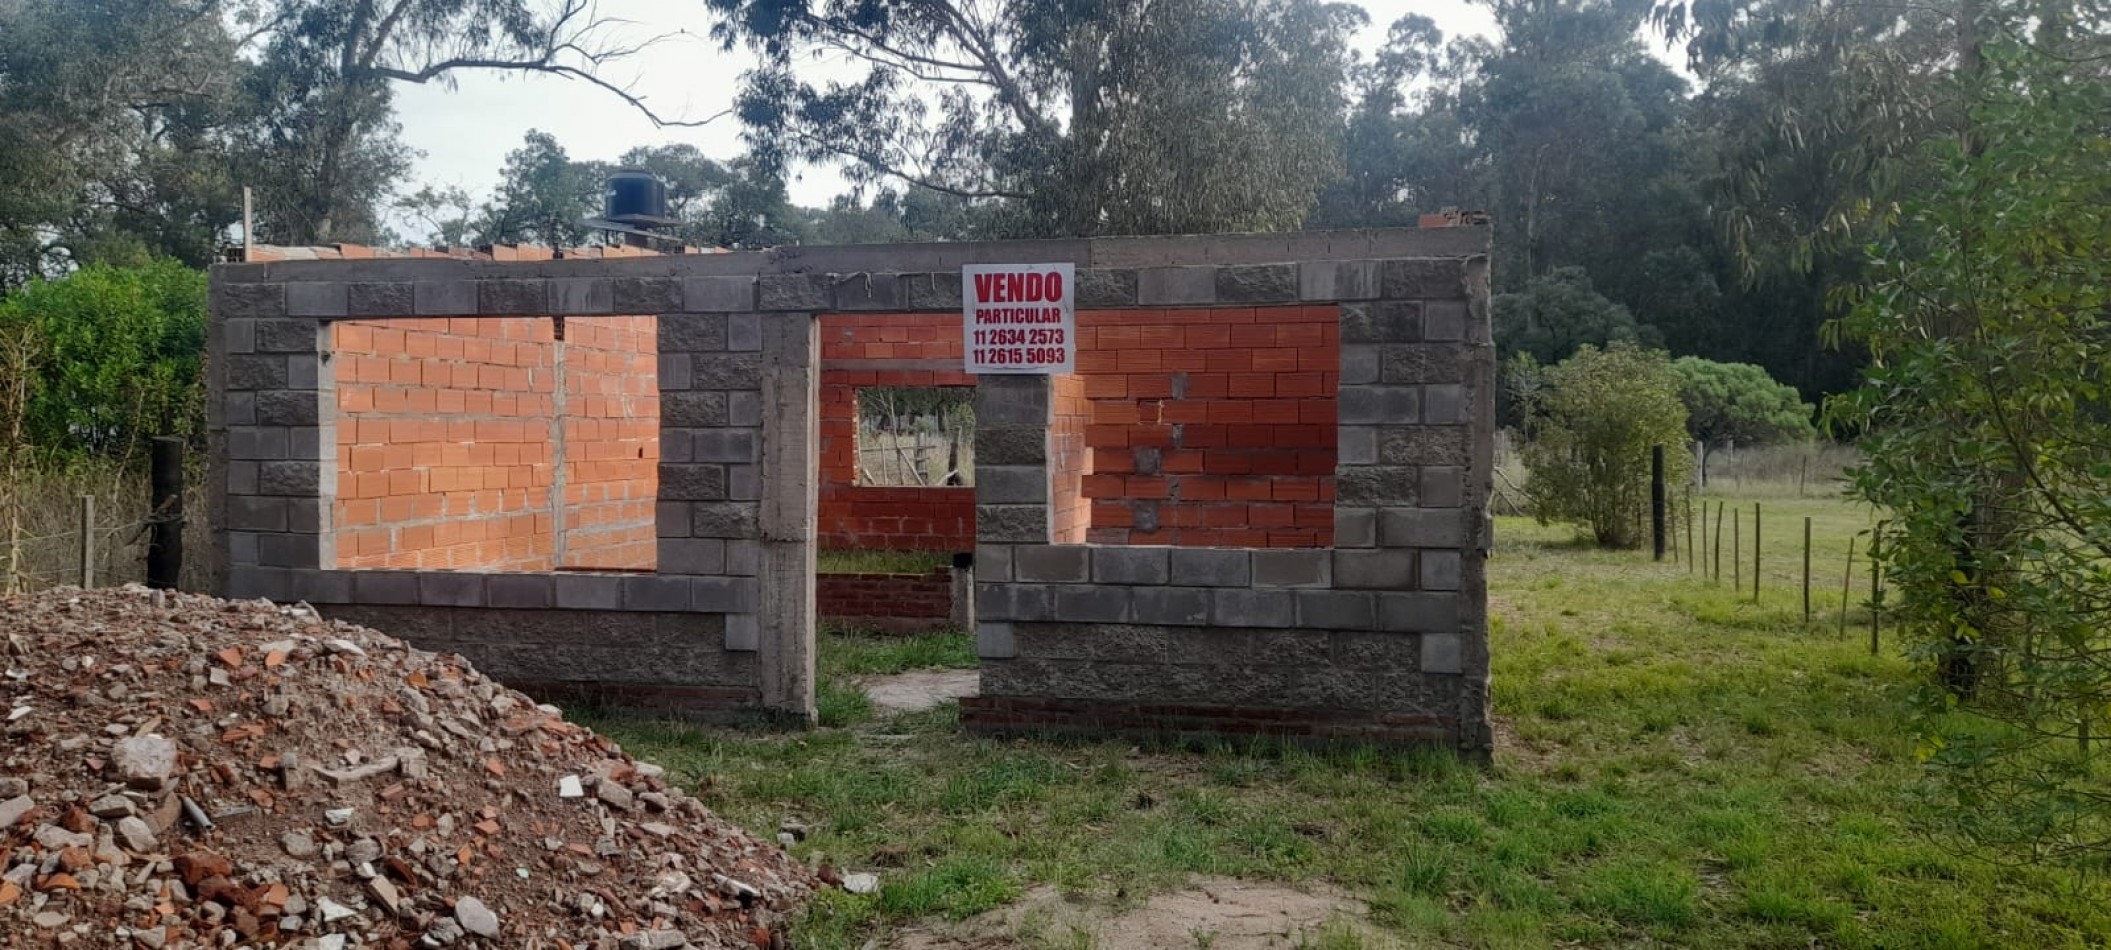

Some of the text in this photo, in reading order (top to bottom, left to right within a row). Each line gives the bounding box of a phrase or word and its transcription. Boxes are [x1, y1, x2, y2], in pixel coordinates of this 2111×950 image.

[974, 271, 1063, 303] VENDO
[975, 307, 1062, 325] PARTICULAR
[973, 328, 1065, 345] 11 2634 2573
[973, 346, 1066, 365] 11 2615 5093
